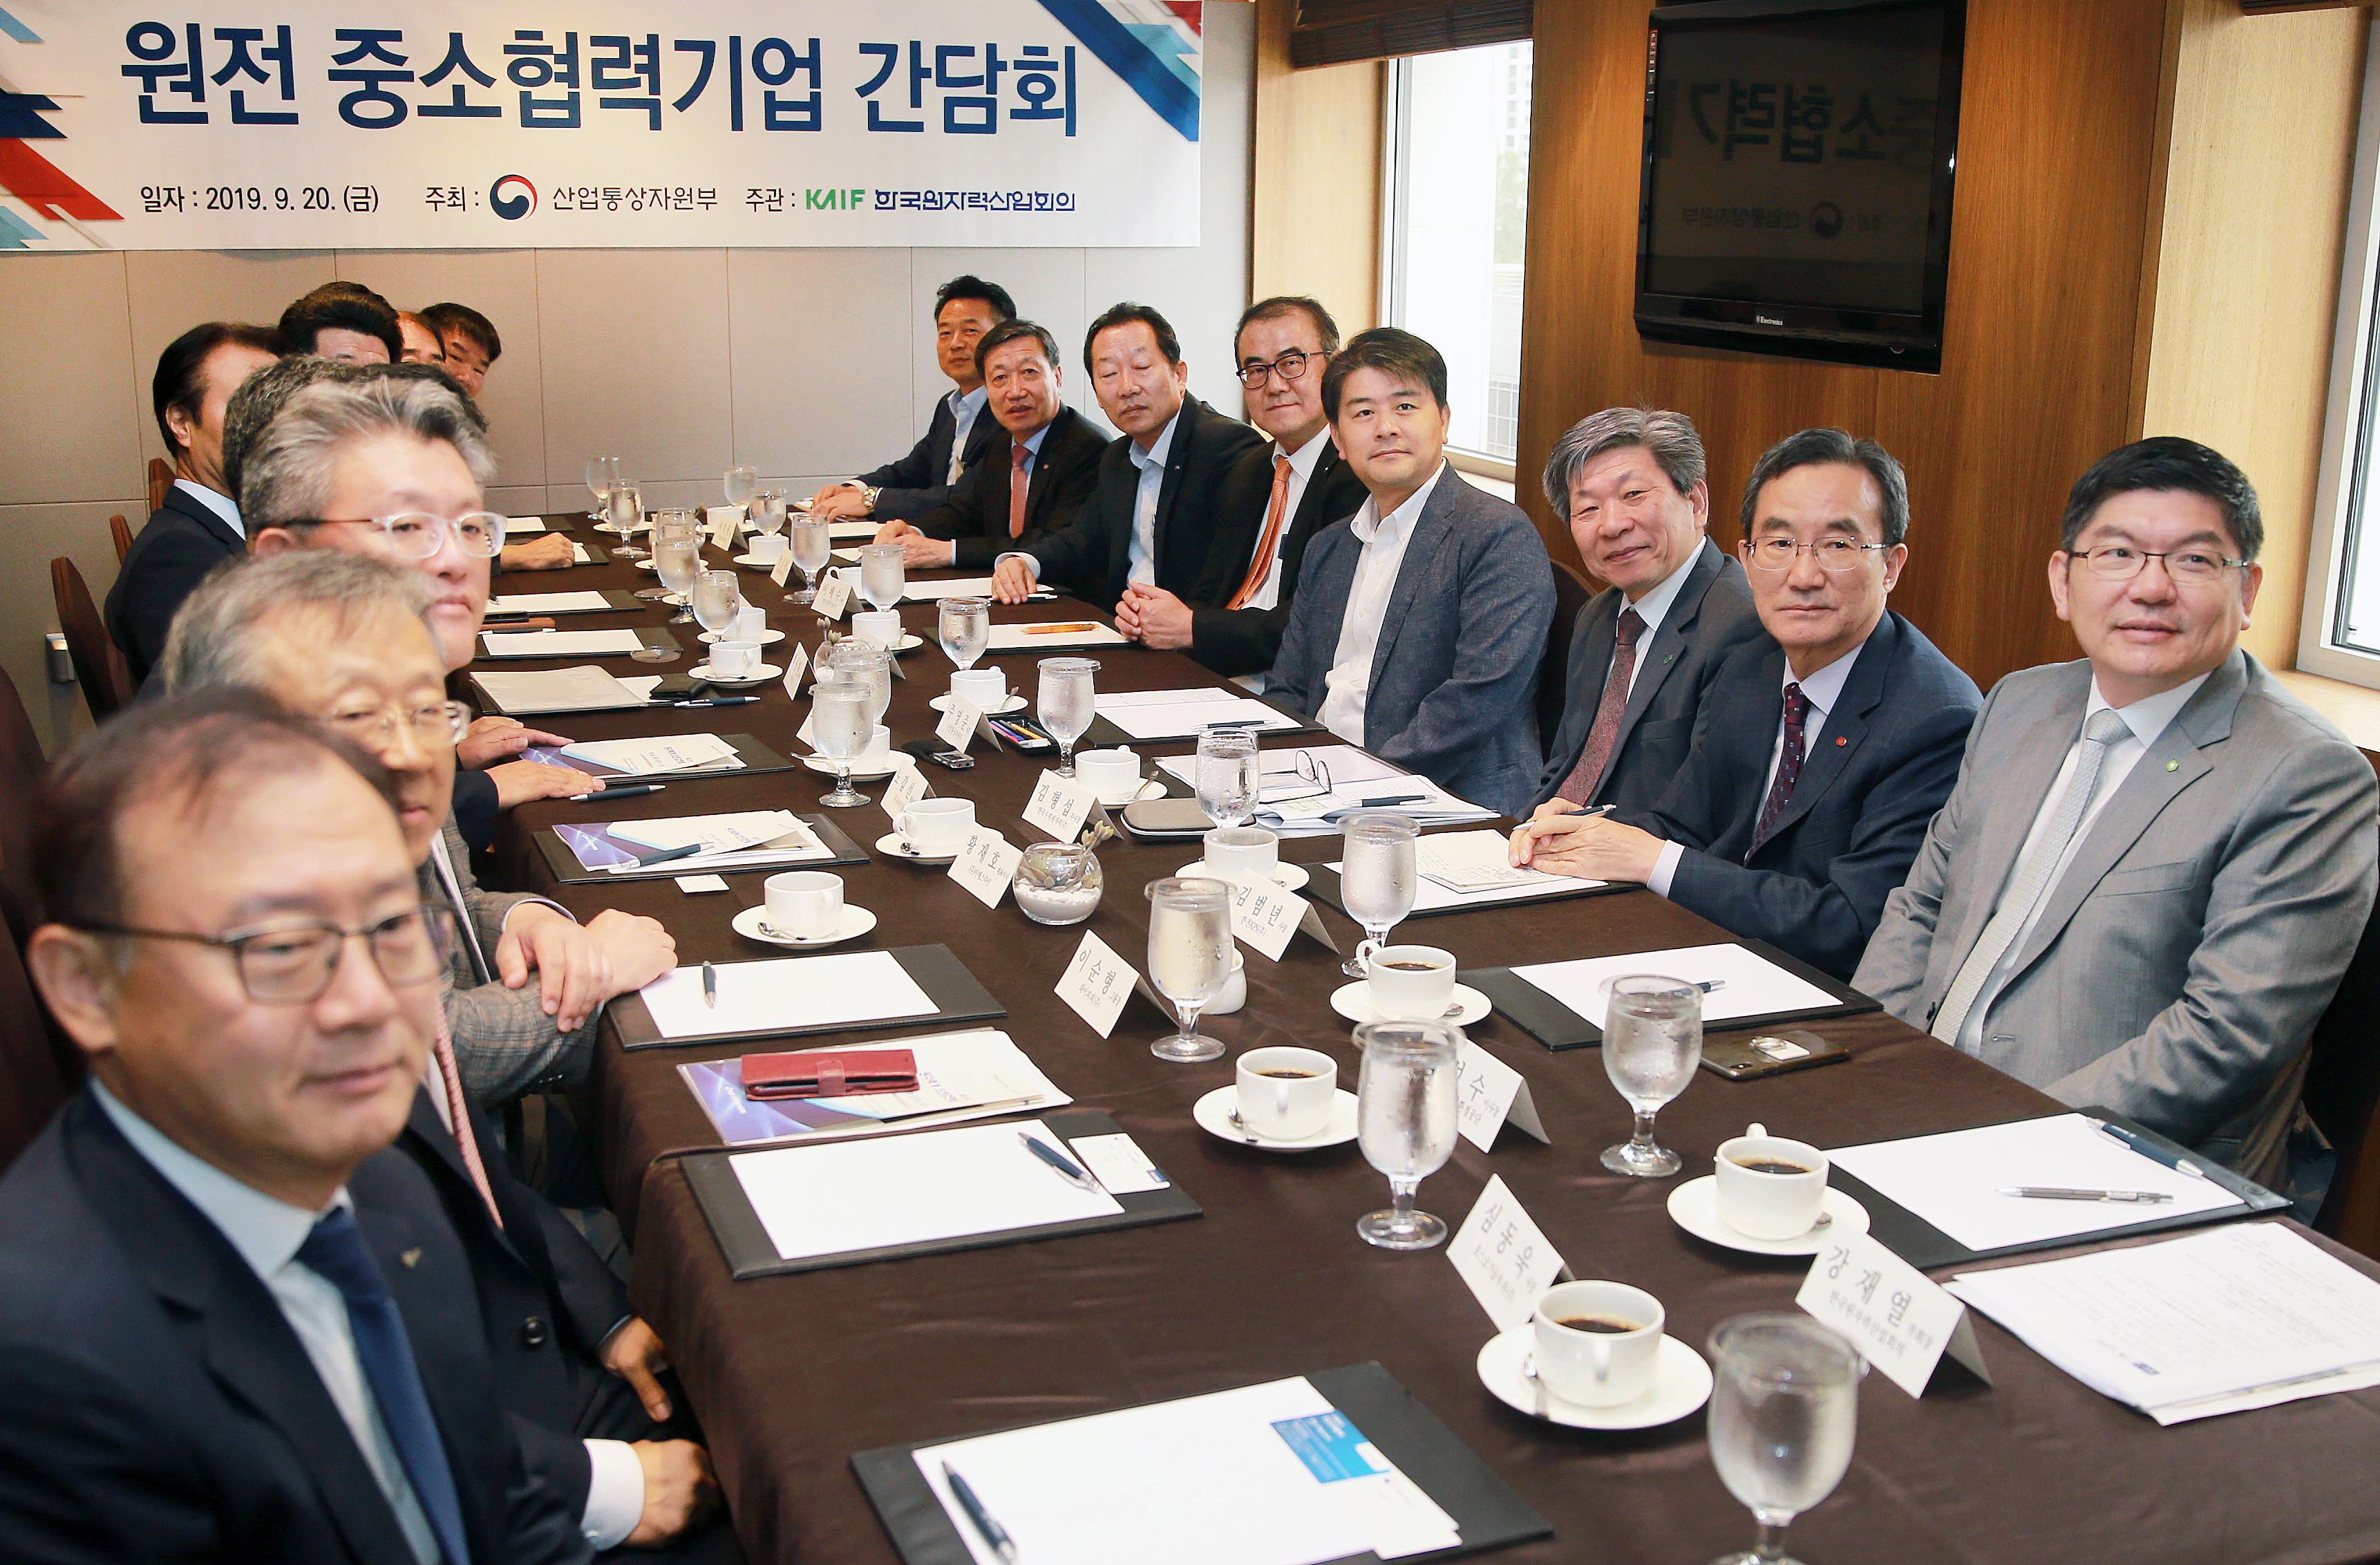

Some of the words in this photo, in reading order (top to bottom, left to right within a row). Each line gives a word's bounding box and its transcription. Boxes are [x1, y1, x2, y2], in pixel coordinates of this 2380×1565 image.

[122, 21, 299, 124] 원전
[328, 29, 822, 131] 중소협력기업
[855, 40, 1076, 137] 간담회
[343, 185, 378, 213] (금)
[553, 187, 717, 211] 산업통상자원부
[806, 189, 865, 209] KAIF
[875, 189, 1075, 211] 한국원자력산업회의
[1236, 886, 1283, 927] 김범년
[1079, 949, 1116, 995] 이순형
[1828, 1246, 1911, 1327] 강재열
